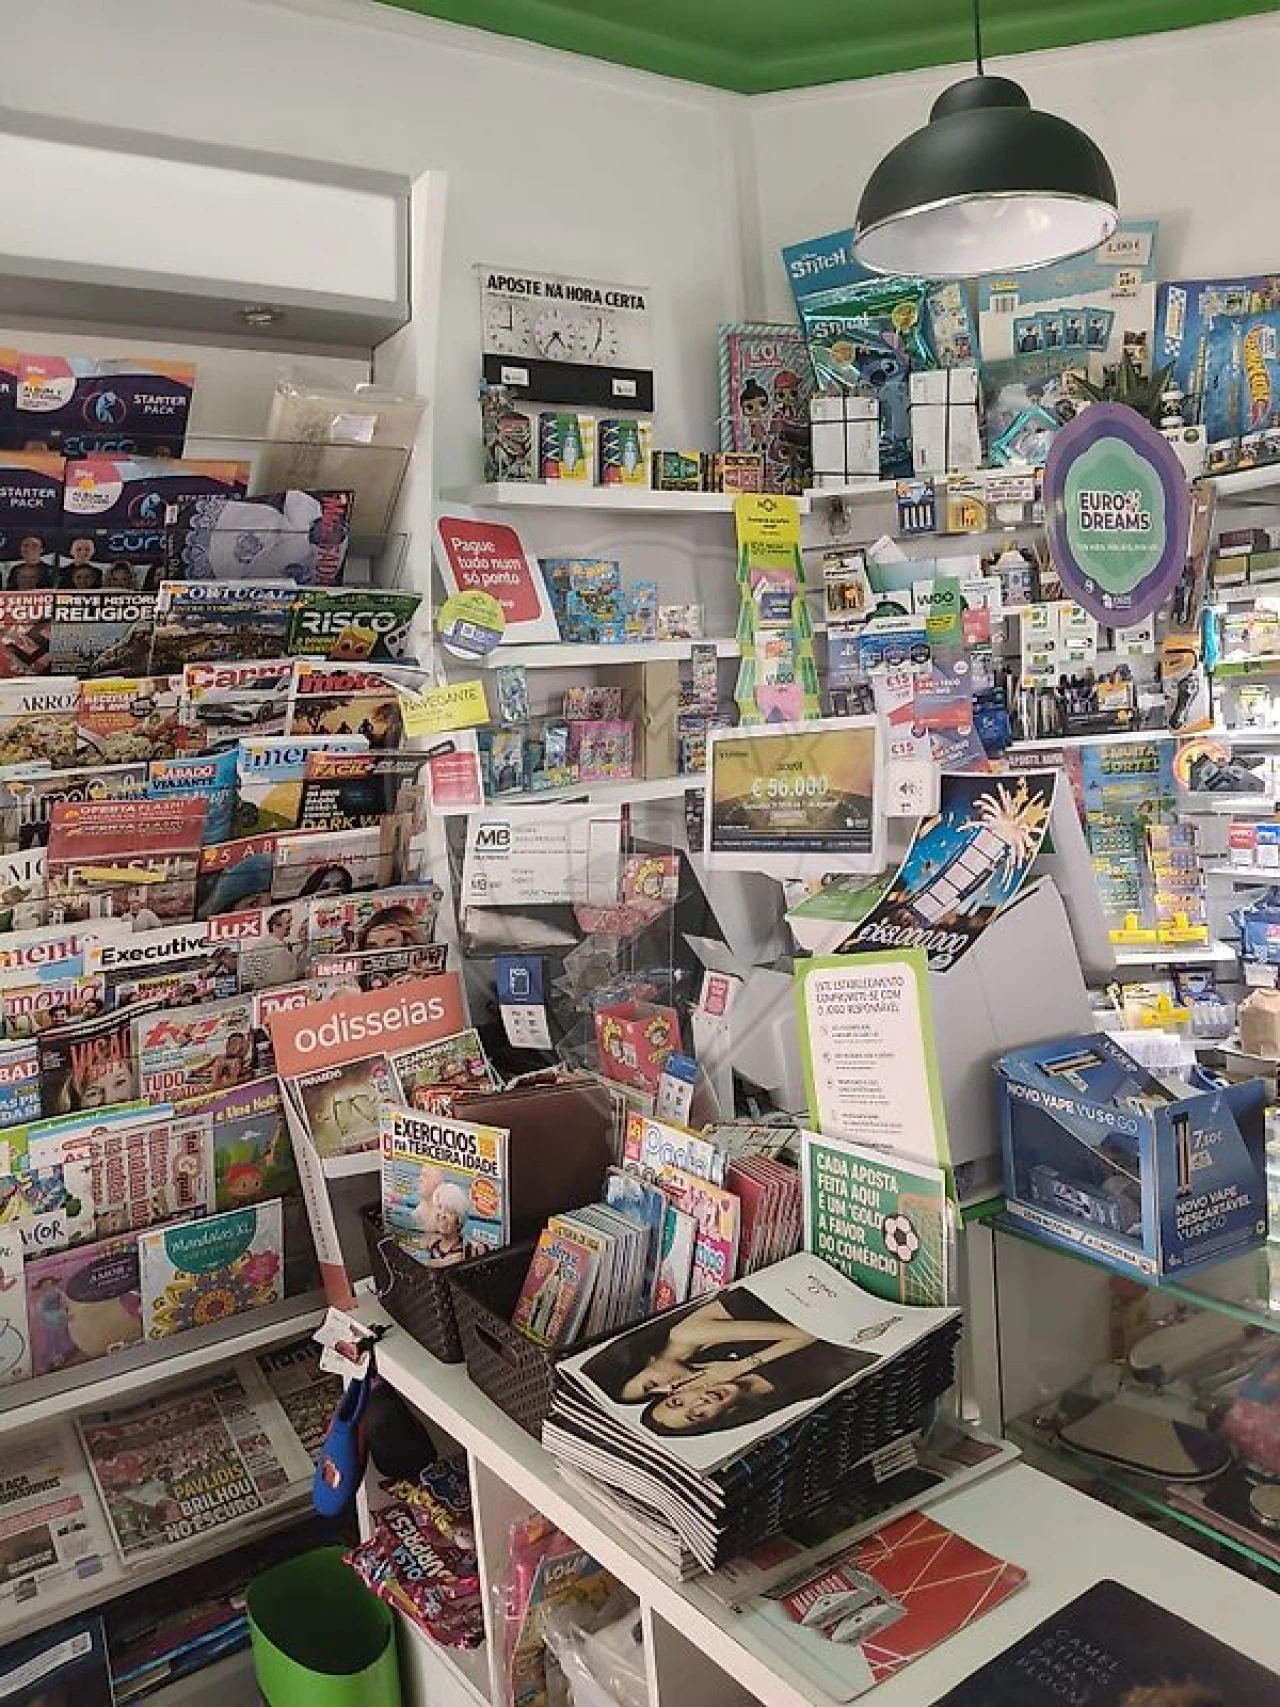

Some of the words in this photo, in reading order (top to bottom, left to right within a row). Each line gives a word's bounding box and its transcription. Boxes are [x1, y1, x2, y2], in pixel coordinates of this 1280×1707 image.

[791, 247, 847, 278] Stitch
[487, 274, 541, 299] APOSTE
[545, 283, 563, 300] NA
[566, 285, 602, 306] HORA
[605, 291, 645, 310] CERTA
[134, 394, 187, 406] STARTER
[144, 405, 174, 415] PACK
[10, 498, 44, 508] PACK
[1080, 492, 1126, 511] EURO
[1081, 512, 1150, 531] DREAMS
[451, 537, 496, 553] Pague
[458, 557, 489, 569] tudo
[492, 558, 521, 570] num
[481, 573, 521, 588] ponto
[917, 590, 954, 606] WOO
[299, 610, 397, 634] RISCO
[475, 829, 511, 847] MB
[101, 936, 205, 965] Executive
[294, 996, 447, 1056] odisseias
[1006, 1081, 1043, 1105] NOVO
[1043, 1095, 1075, 1115] VAPE
[410, 1139, 460, 1169] TERCEIRA
[460, 1153, 498, 1178] IDADE
[817, 1152, 848, 1177] CADA
[851, 1164, 899, 1194] APOSTA
[817, 1172, 848, 1198] FEITA
[851, 1183, 880, 1209] AQUI
[1177, 1194, 1209, 1216] NOVO
[1210, 1185, 1240, 1207] VAPE
[827, 1195, 846, 1217] UM
[829, 1215, 866, 1245] FAVOR
[818, 1233, 835, 1252] DO
[837, 1239, 897, 1277] COMÉRCIO
[180, 1481, 253, 1516] BRILHOU
[165, 1519, 194, 1544] NO
